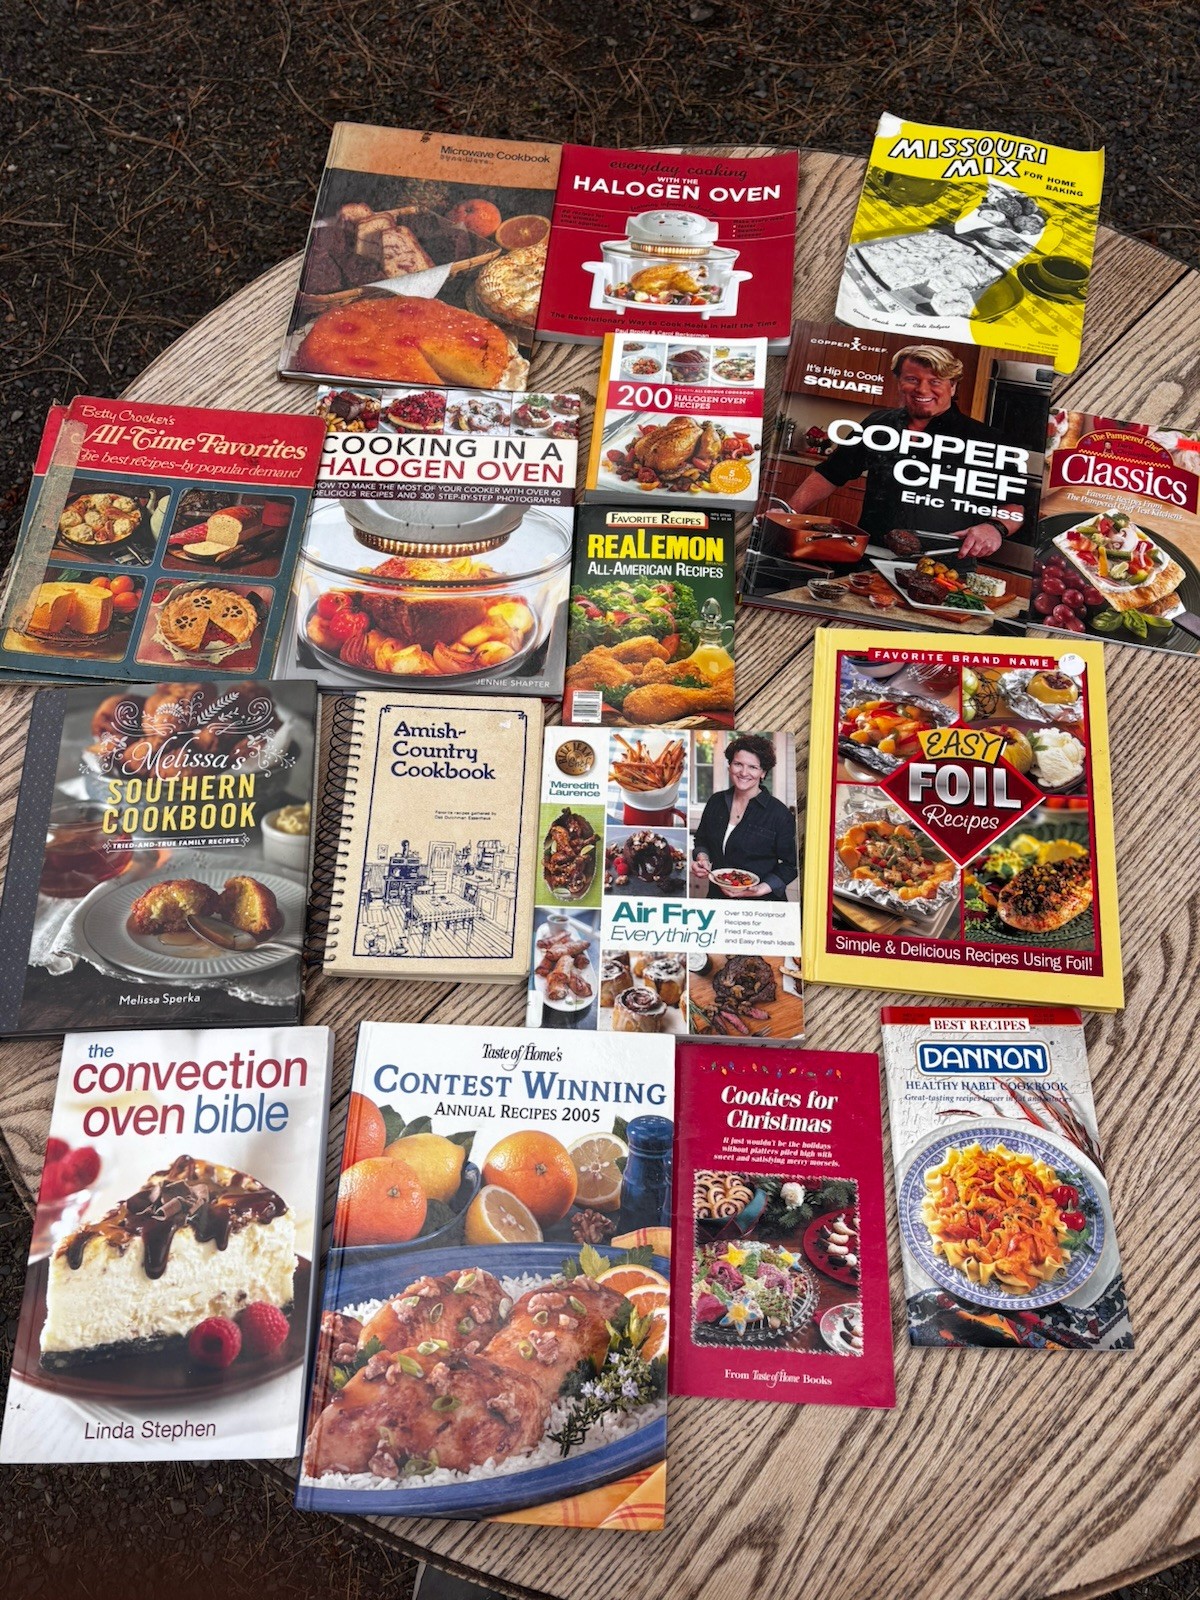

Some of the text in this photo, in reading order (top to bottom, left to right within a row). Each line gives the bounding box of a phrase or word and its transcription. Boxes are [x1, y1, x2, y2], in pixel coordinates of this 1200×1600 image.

[440, 145, 550, 163] Microwave Cookbook
[888, 136, 1048, 165] MISSOURI
[609, 160, 748, 182] everyday cooking
[941, 157, 1022, 179] MIX
[1023, 170, 1076, 187] FOR HOME
[573, 175, 781, 203] HALOGEN OVEN
[657, 176, 699, 185] WITH THE
[1045, 184, 1084, 197] BAKING
[810, 338, 887, 353] COPPER CHEF
[806, 363, 885, 382] It's Hip to Cook
[803, 374, 884, 396] SQUARE
[617, 384, 673, 409] 200
[673, 401, 711, 410] RECIPES
[674, 394, 747, 405] HALOGEN OVEN
[80, 404, 176, 426] Betty Crocker's
[71, 424, 308, 460] All-Time Favorites
[322, 435, 563, 462] COOKING IN A
[827, 419, 1030, 474] COPPER
[1090, 433, 1106, 442] The
[1105, 431, 1144, 445] Pampered
[1144, 439, 1164, 454] Chef
[77, 448, 100, 463] The
[101, 450, 129, 466] best
[197, 461, 249, 478] popular
[249, 463, 302, 479] demand
[320, 457, 564, 484] HALOGEN OVEN
[338, 481, 350, 489] TO
[351, 482, 376, 490] MAKE
[379, 483, 395, 491] THE
[423, 484, 436, 492] OF
[439, 485, 462, 493] YOUR
[463, 486, 500, 494] COOKER
[502, 487, 524, 495] WITH
[526, 488, 549, 496] OVER
[551, 489, 562, 497] 60
[893, 458, 1028, 501] CHEF
[1061, 453, 1188, 507] Classics
[314, 489, 561, 505] DELICIOUS RECIPES AND 300 STEP-BY-STEP PHOTOGRAPHS
[901, 490, 1024, 523] Eric Theiss
[611, 513, 658, 524] FAVORITE
[661, 514, 702, 526] RECIPES
[587, 561, 672, 577] ALL-AMERICAN
[675, 562, 724, 579] RECIPES
[874, 650, 944, 662] FAVORITE
[952, 653, 1001, 665] BRAND
[1009, 656, 1049, 667] NAME
[475, 678, 550, 689] JENNIE SHAPTER
[393, 720, 467, 739] Amish-
[392, 740, 478, 763] Country
[926, 730, 1001, 760] EASY
[121, 736, 247, 781] Melissa's
[391, 760, 496, 780] Cookbook
[107, 773, 256, 805] SOUTHERN
[549, 788, 600, 797] Laurence
[550, 780, 599, 790] Meredith
[908, 762, 1022, 810] FOIL
[102, 801, 257, 835] COOKBOOK
[921, 803, 1000, 834] Recipes
[112, 837, 240, 849] TRIED-AND-TRUE FAMILY RECIPES
[612, 901, 716, 931] Air Fry
[724, 920, 751, 928] Recipes
[754, 911, 786, 919] Foolproof
[610, 925, 718, 948] Everything!
[739, 938, 755, 946] Easy
[835, 935, 1093, 972] Simple & Delicious Recipes Using Foil!
[119, 992, 201, 1005] Melissa Sperka
[934, 1019, 1026, 1031] BEST RECIPES
[88, 1043, 114, 1058] the
[482, 1043, 509, 1060] Taste
[524, 1042, 563, 1062] Home's
[923, 1047, 1044, 1070] DANNON
[73, 1050, 308, 1094] convection
[373, 1064, 667, 1106] CONTEST WINNING
[905, 1080, 1069, 1092] HEALTHY HABIT COOKBOOK
[721, 1085, 838, 1110] Cookies for
[82, 1092, 289, 1137] oven bible
[433, 1101, 600, 1123] ANNUAL RECIPES 2005
[726, 1109, 832, 1133] Christmas
[722, 1145, 833, 1158] without platters piled high with
[730, 1137, 745, 1145] just
[746, 1138, 776, 1147] wouldn't
[802, 1141, 832, 1150] holidays
[751, 1156, 786, 1165] satisfying
[786, 1158, 808, 1166] merry
[809, 1159, 840, 1168] morsels.
[724, 1368, 750, 1380] From
[752, 1369, 771, 1381] Taste
[779, 1368, 800, 1383] Home
[803, 1374, 833, 1386] Books
[84, 1419, 217, 1442] Linda Stephen
